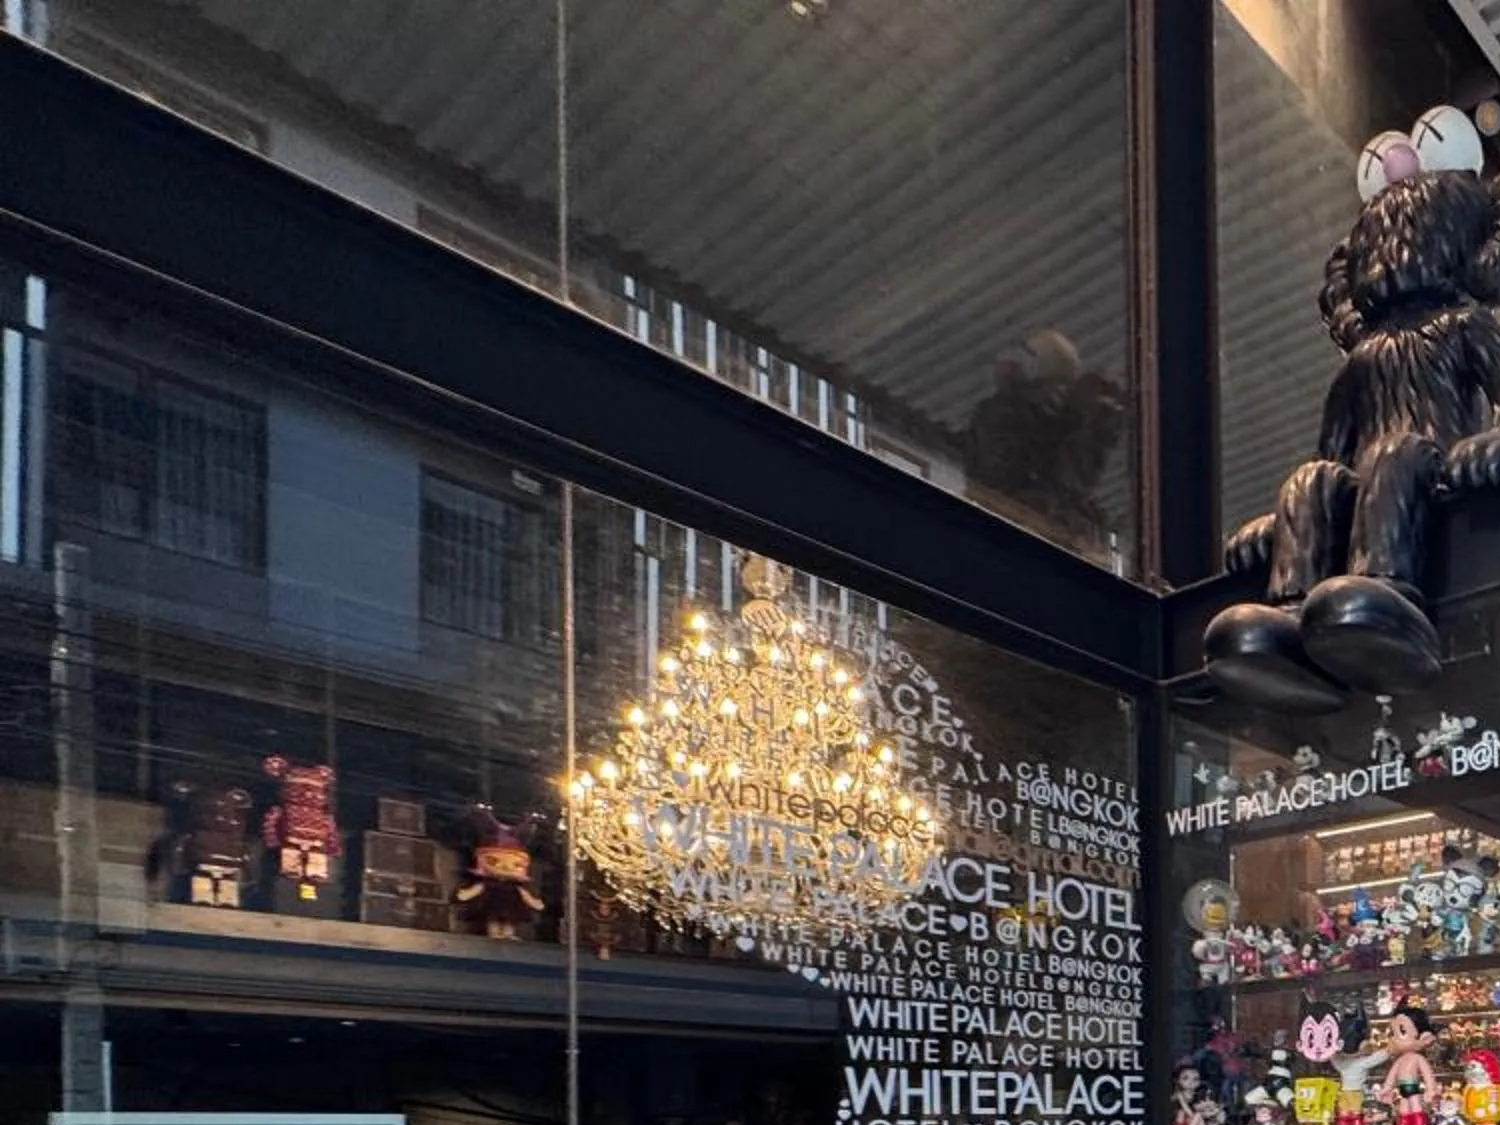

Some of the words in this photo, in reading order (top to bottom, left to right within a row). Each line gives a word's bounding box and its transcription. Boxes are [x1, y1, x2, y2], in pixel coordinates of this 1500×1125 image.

[1065, 767, 1140, 804] HOTEL
[1165, 798, 1229, 836] WHITE
[1234, 779, 1322, 822] PALACE
[1328, 759, 1409, 802] HOTEL
[1027, 870, 1143, 931] HOTEL
[965, 945, 1042, 974] HOTEL
[969, 911, 1142, 963] B@NGKOK
[760, 941, 848, 970] WHITE
[860, 953, 957, 981] PALACE
[969, 965, 1039, 989] HOTEL
[829, 970, 906, 998] WHITE
[911, 979, 995, 1006] PALACE
[1000, 988, 1057, 1012] HOTEL
[848, 996, 949, 1033] WHITE
[951, 1003, 1062, 1042] PALACE
[1067, 1015, 1144, 1046] HOTEL
[846, 1035, 941, 1063] WHITE
[951, 1040, 1055, 1068] PALACE
[1066, 1047, 1144, 1071] HOTEL
